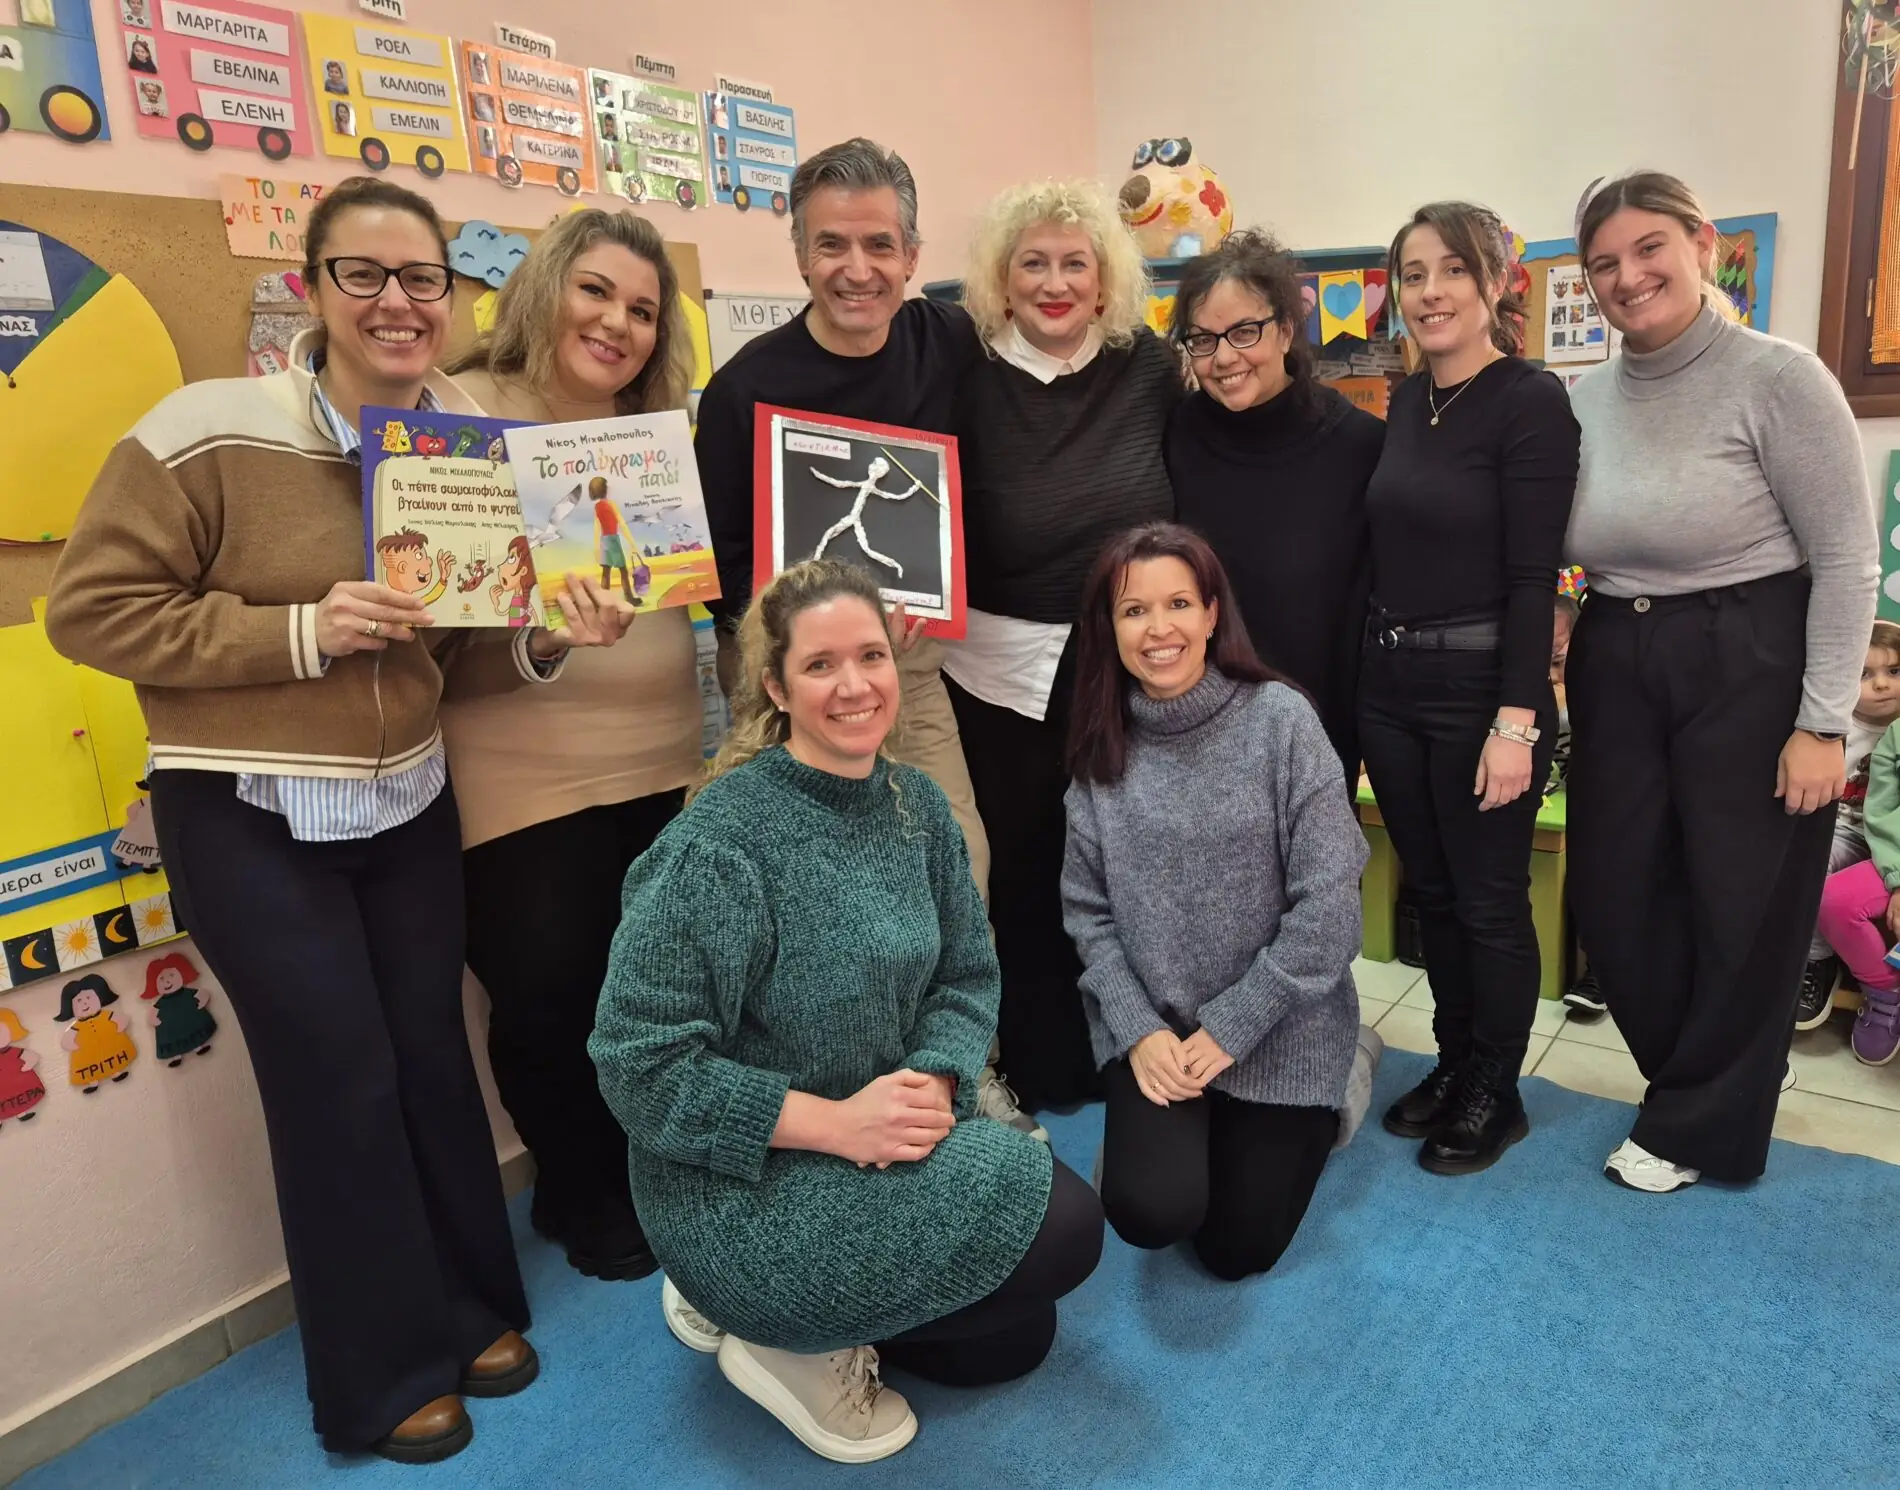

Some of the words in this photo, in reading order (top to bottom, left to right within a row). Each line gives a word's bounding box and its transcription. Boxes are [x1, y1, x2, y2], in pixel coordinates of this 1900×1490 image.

[176, 10, 268, 43] ΜΑΡΓΑΡΙΤΑ
[375, 37, 411, 56] ΡΟΕΛ
[500, 26, 551, 58] Τετάρτη
[213, 58, 280, 86] ΕΒΕΛΙΝΑ
[635, 54, 675, 78] Πέμπτη
[379, 74, 446, 98] ΚΑΛΛΙΟΠΗ
[506, 67, 575, 96] ΜΑΡΙΛΕΝΑ
[719, 78, 772, 102] Παρασκευή
[221, 99, 286, 123] ΕΛΕΝΗ
[390, 112, 440, 132] ΕΜΕΛΙΝ
[745, 109, 786, 132] ΒΑΣΙΛΗΣ
[526, 140, 580, 160] ΚΑΤΕΡΙΝΑ
[739, 143, 776, 159] ΣΤΑΥΡΟΣ
[245, 177, 276, 199] ΤΟ
[532, 454, 559, 479] Το
[563, 447, 667, 479] πολύχρωμο
[639, 459, 680, 489] παιδί
[392, 478, 404, 491] Οι
[407, 480, 438, 493] πέντε
[398, 496, 448, 512] βγαίνουν
[452, 501, 474, 513] από
[477, 503, 487, 513] το
[54, 856, 96, 878] είναι
[76, 1050, 129, 1080] ΤΡΙΤΗ
